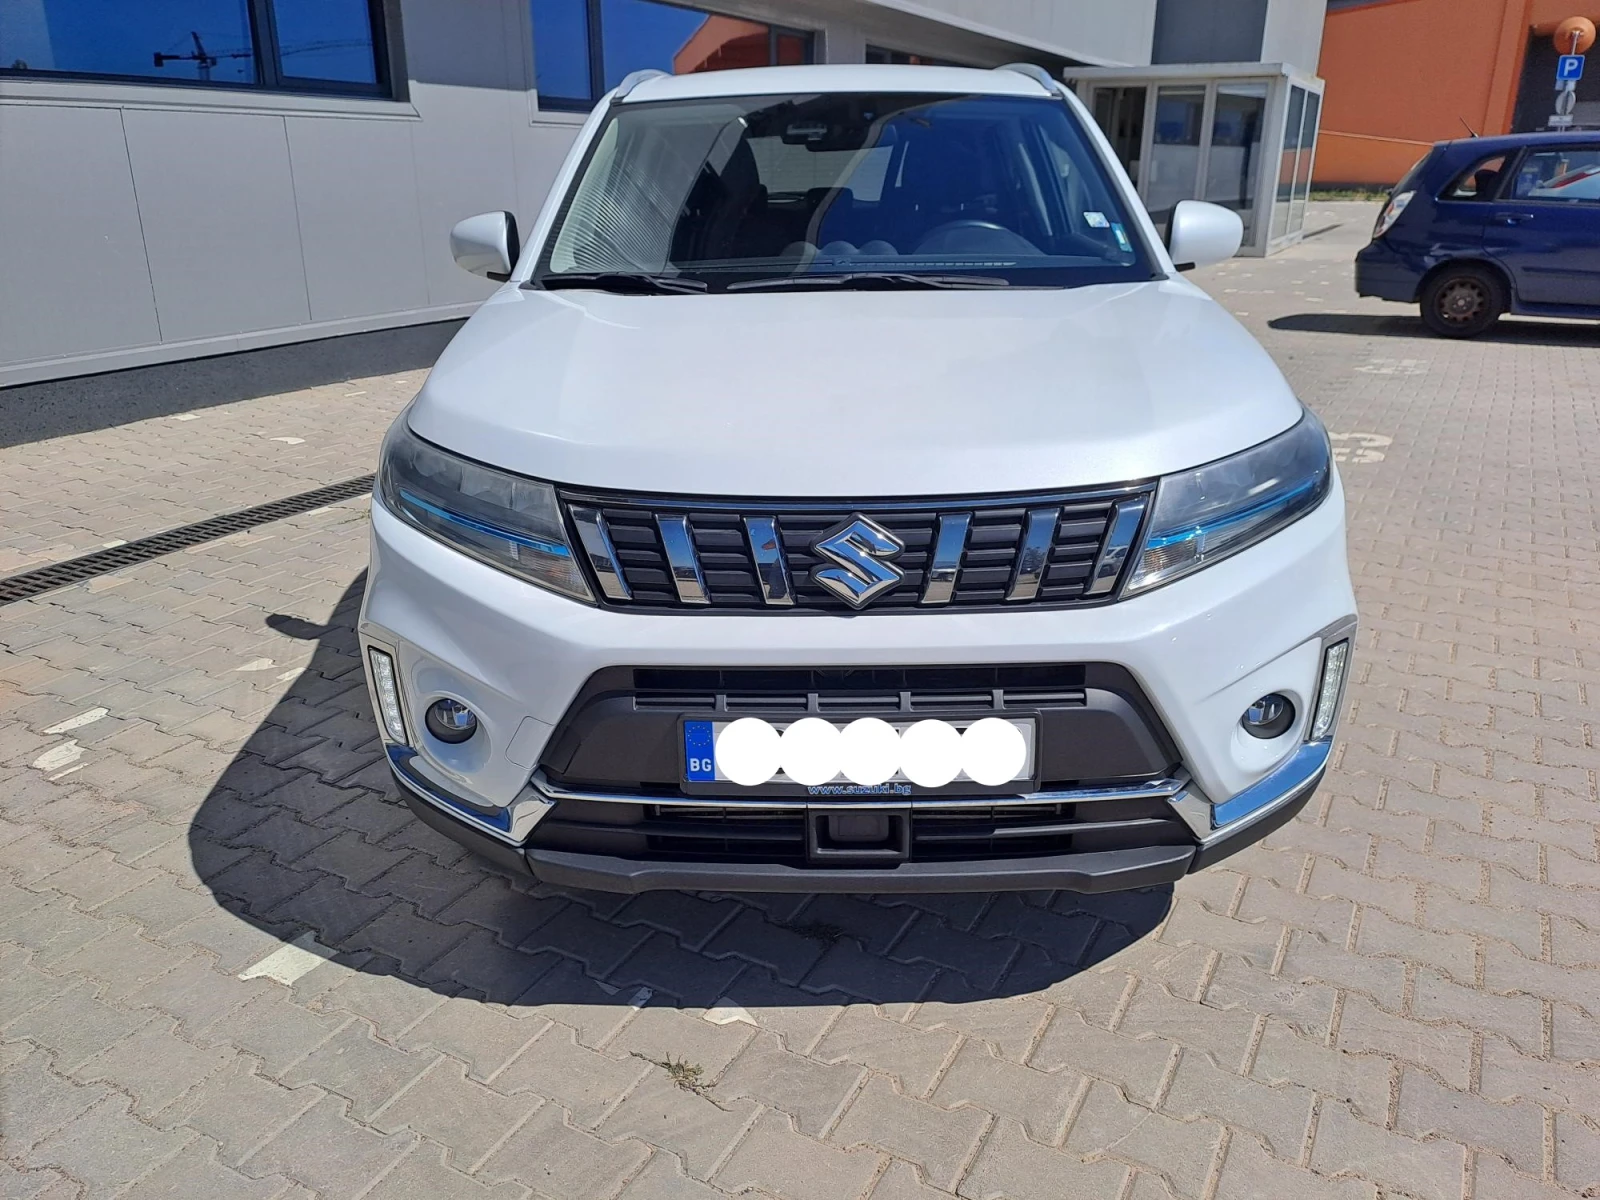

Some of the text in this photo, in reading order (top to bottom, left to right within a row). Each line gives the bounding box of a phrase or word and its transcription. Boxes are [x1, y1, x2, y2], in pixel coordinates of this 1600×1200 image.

[1563, 58, 1579, 77] P
[689, 757, 712, 772] BG
[807, 783, 912, 796] www.suzuki.bg
